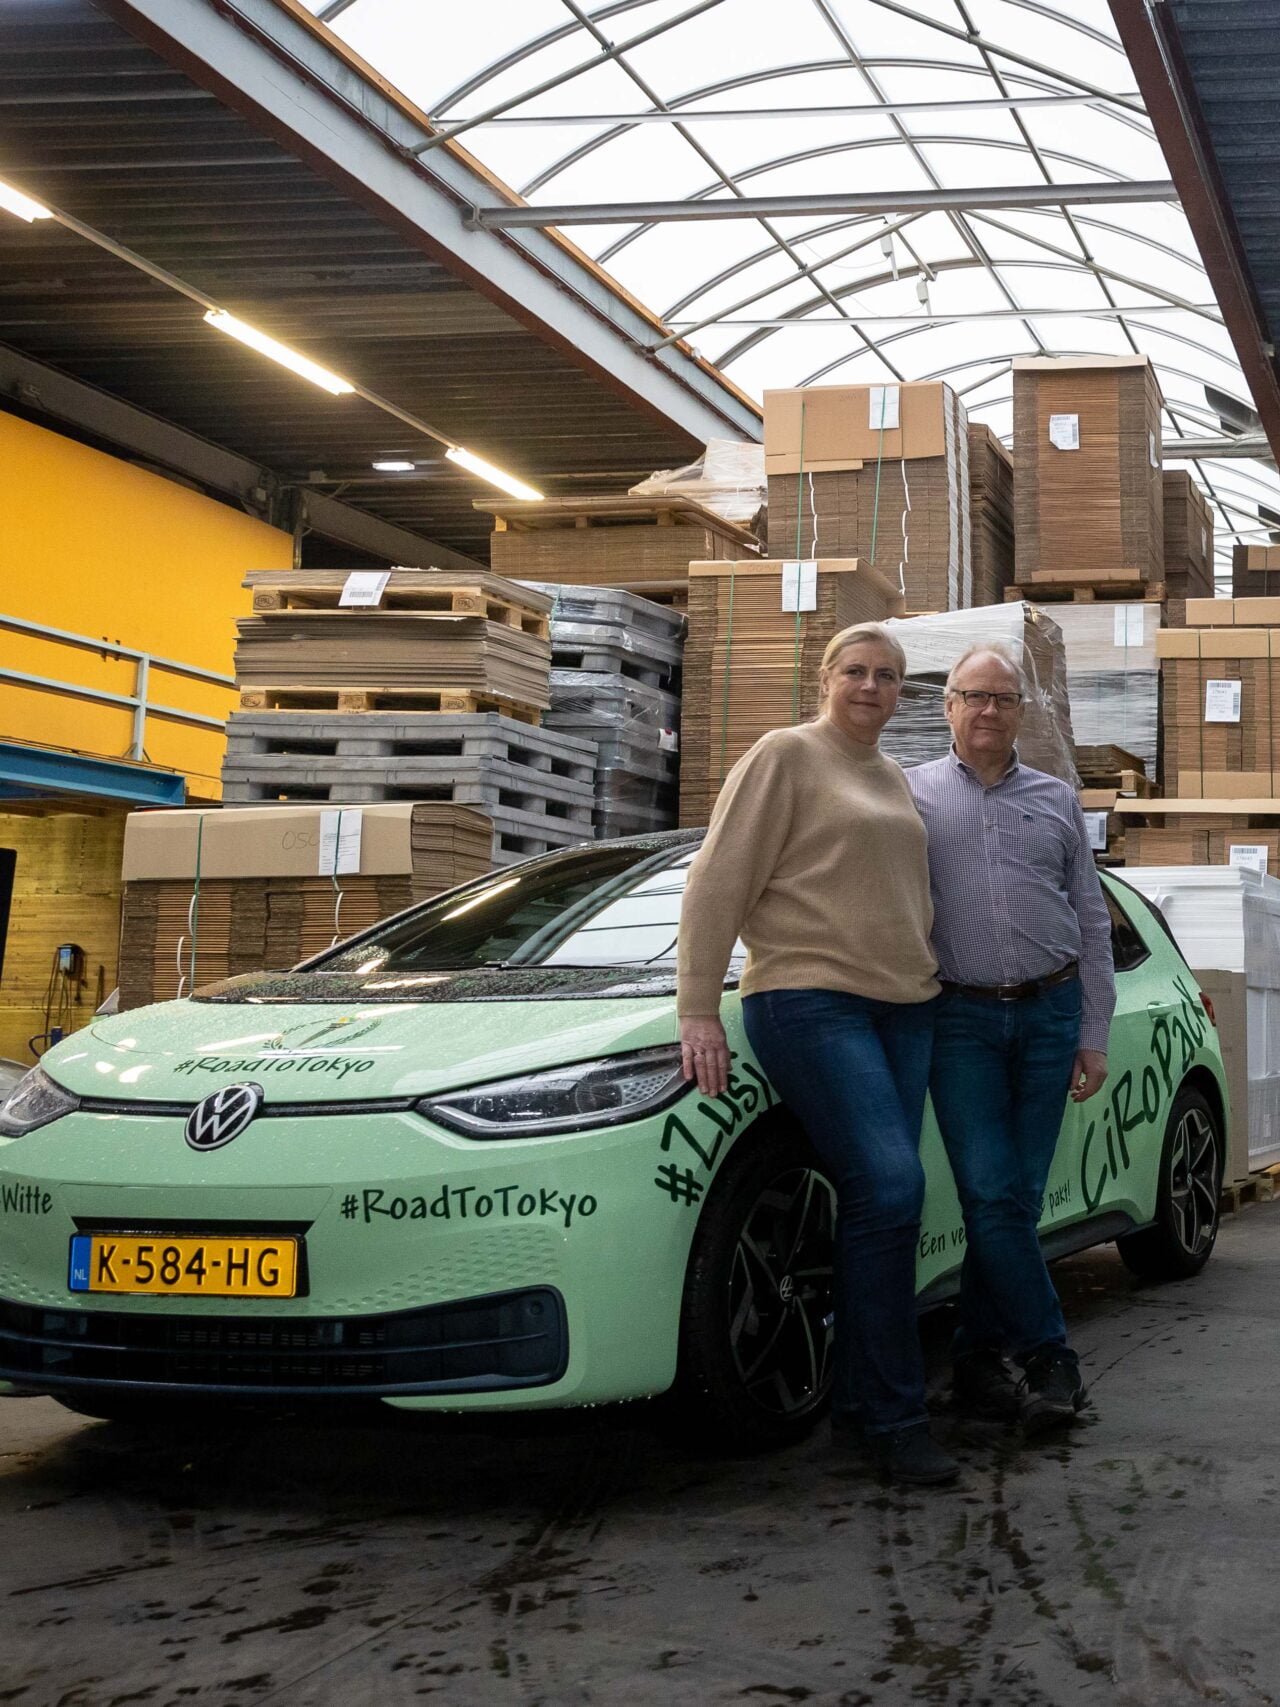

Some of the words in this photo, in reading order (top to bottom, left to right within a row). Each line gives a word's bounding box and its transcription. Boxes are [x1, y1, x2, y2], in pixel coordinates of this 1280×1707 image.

[173, 1056, 376, 1080] #RoadToTokyo
[340, 1184, 598, 1228] #RoadToTokyo
[1049, 1179, 1072, 1217] pakt!
[919, 1231, 946, 1259] Een
[74, 1269, 88, 1281] NL
[98, 1244, 280, 1287] K-584-HG
